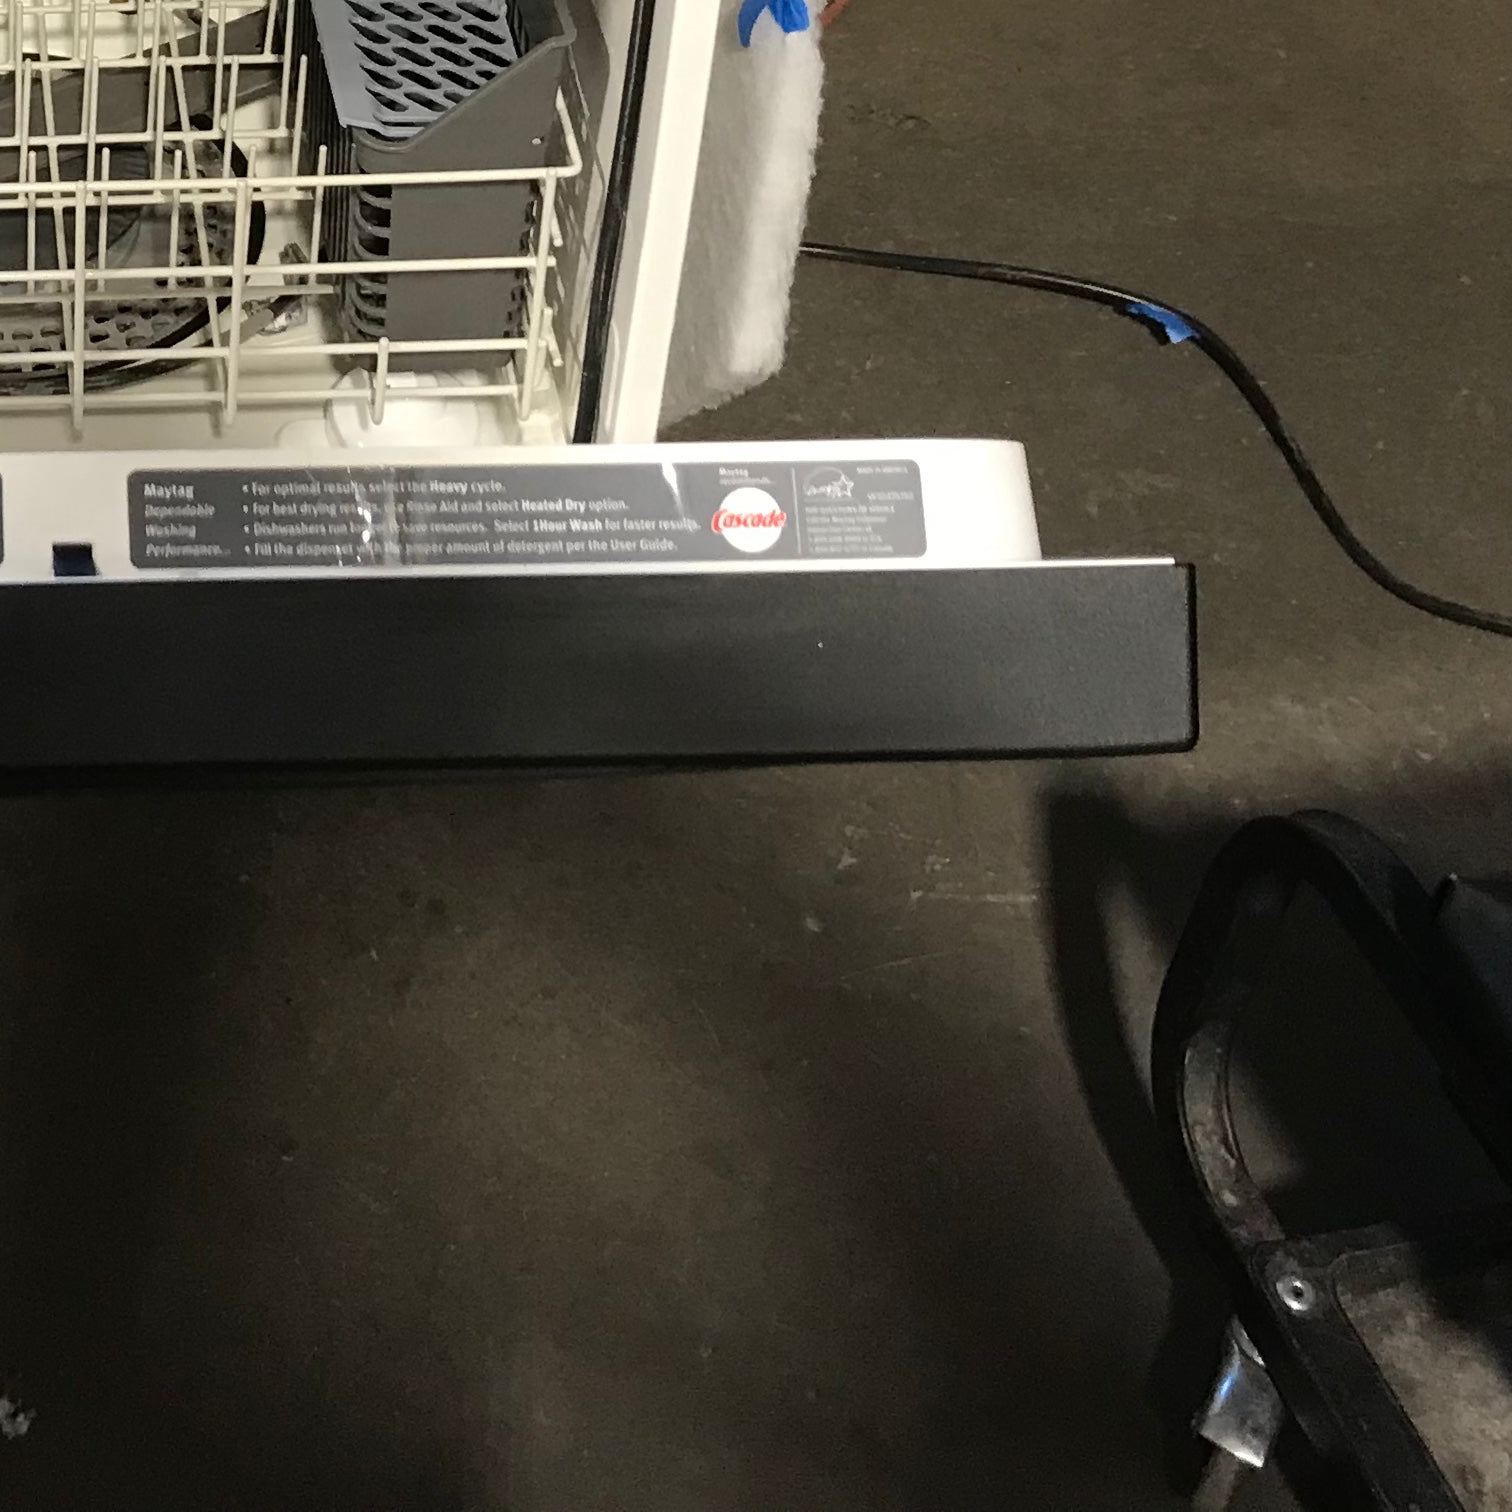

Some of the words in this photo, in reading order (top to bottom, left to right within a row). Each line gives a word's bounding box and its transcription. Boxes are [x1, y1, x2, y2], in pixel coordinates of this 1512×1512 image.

[144, 483, 194, 499] Maytag
[430, 479, 467, 495] Heavy
[522, 497, 563, 513] Heated
[569, 518, 602, 532] Wash
[712, 509, 787, 533] Cascade
[610, 538, 637, 552] User
